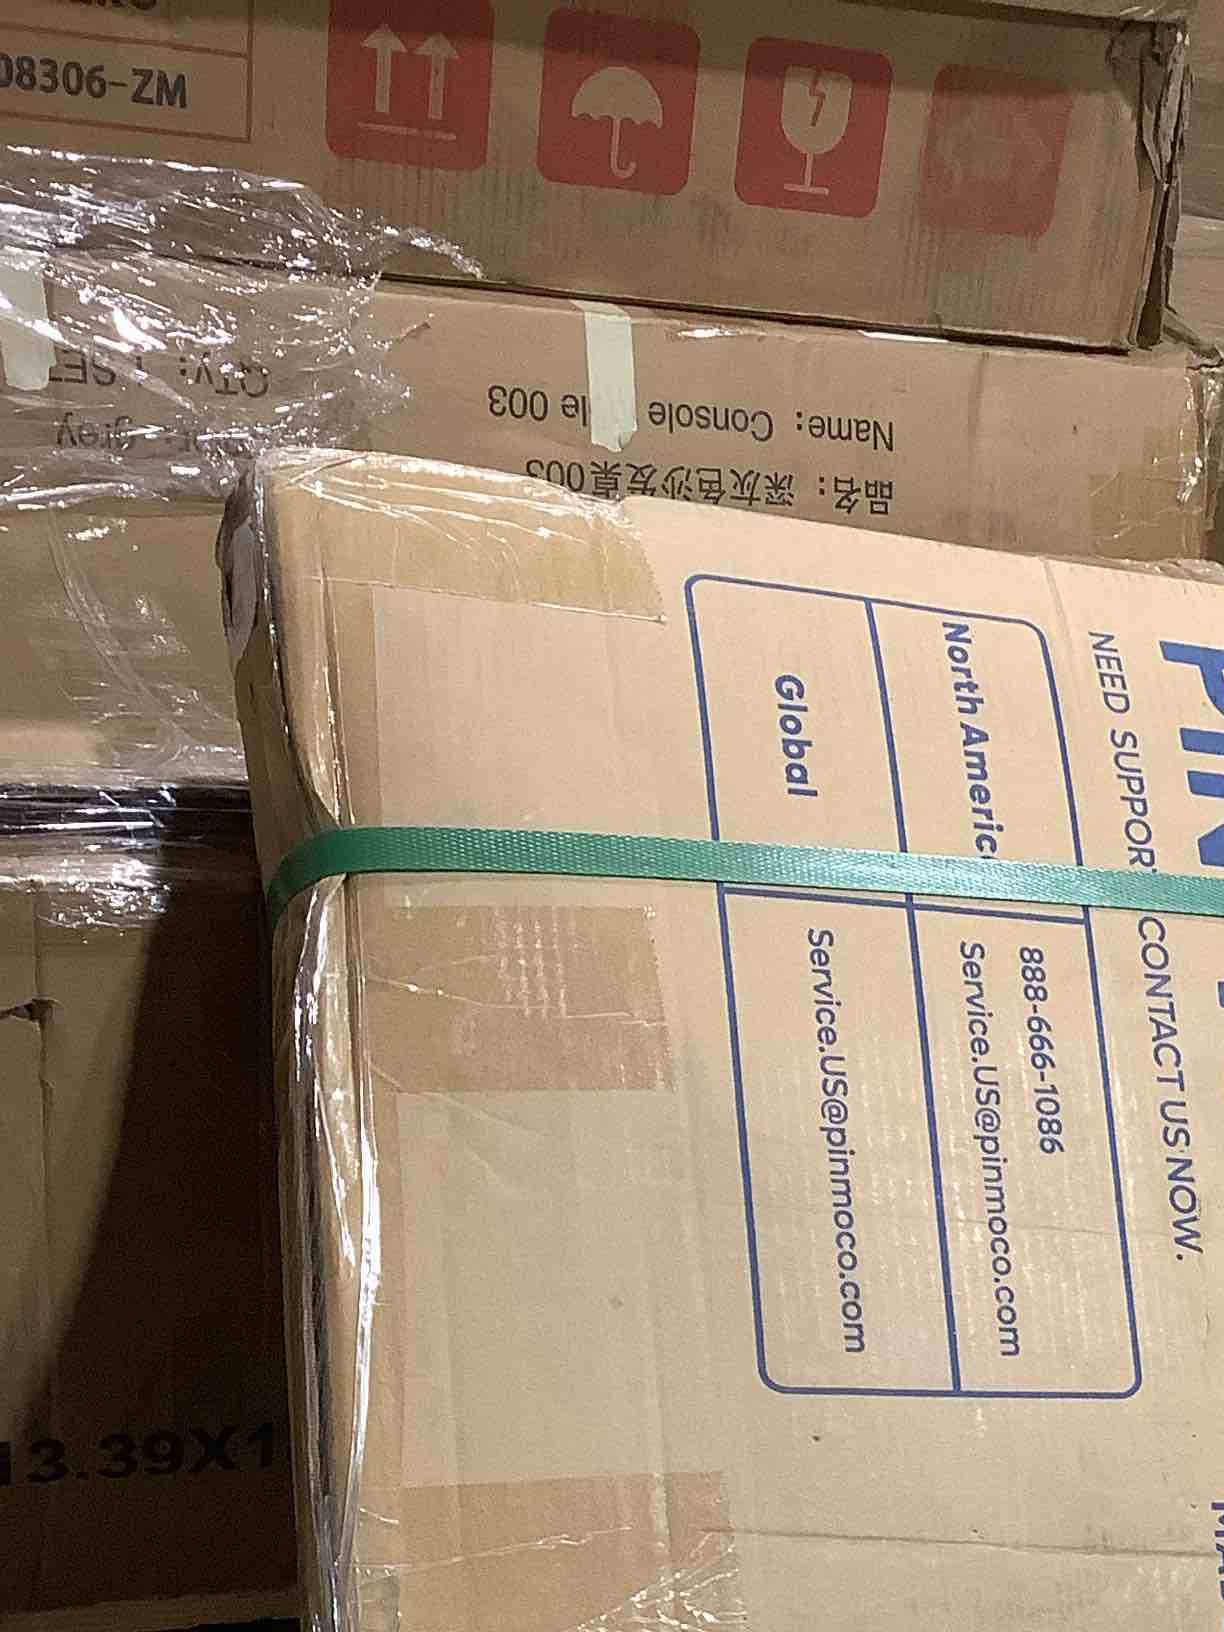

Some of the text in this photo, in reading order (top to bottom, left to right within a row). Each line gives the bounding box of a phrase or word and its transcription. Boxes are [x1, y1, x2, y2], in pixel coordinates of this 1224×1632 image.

[49, 348, 117, 386] SE
[488, 384, 549, 422] 003
[648, 400, 774, 443] Console
[774, 673, 819, 797] Global
[943, 620, 999, 862] North Americ
[1019, 945, 1064, 1154] 888-666-1086
[1088, 630, 1205, 1262] NEED SUPPOR CONTACT US NOW.
[807, 927, 866, 1353] Service.US@pinmoco.com
[960, 941, 1021, 1357] Service.US@pinmoco.com
